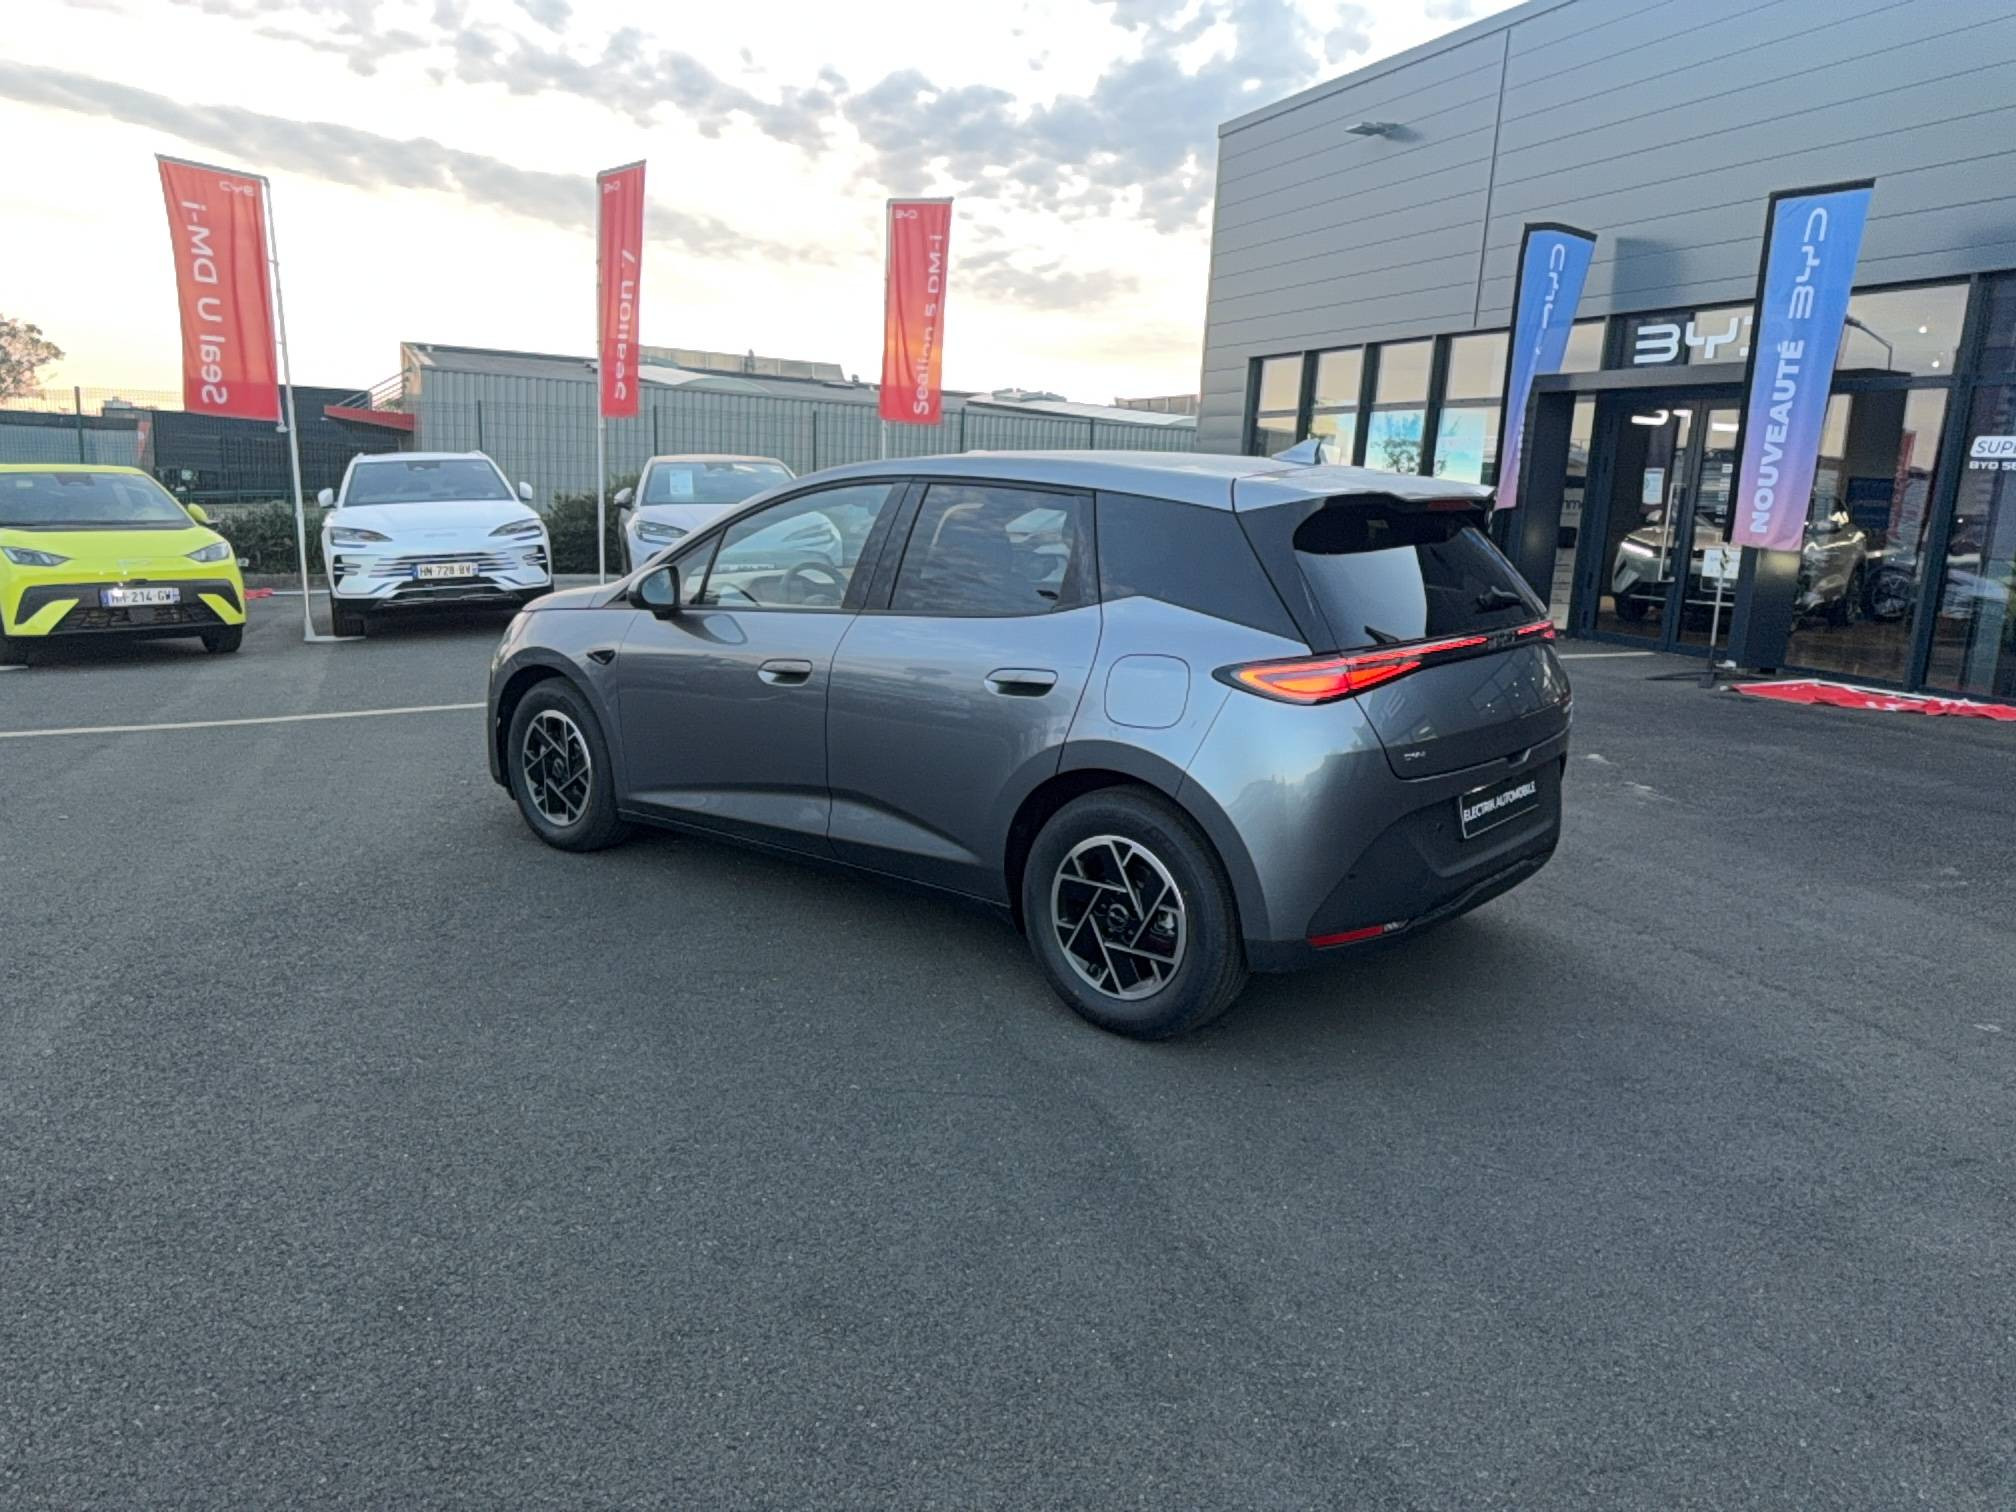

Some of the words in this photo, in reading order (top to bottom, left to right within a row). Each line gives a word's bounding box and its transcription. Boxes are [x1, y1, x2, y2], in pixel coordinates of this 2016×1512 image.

[1750, 340, 1805, 534] NOUVEAUTÉ
[1788, 207, 1829, 320] BYD
[1968, 461, 1999, 470] BYD
